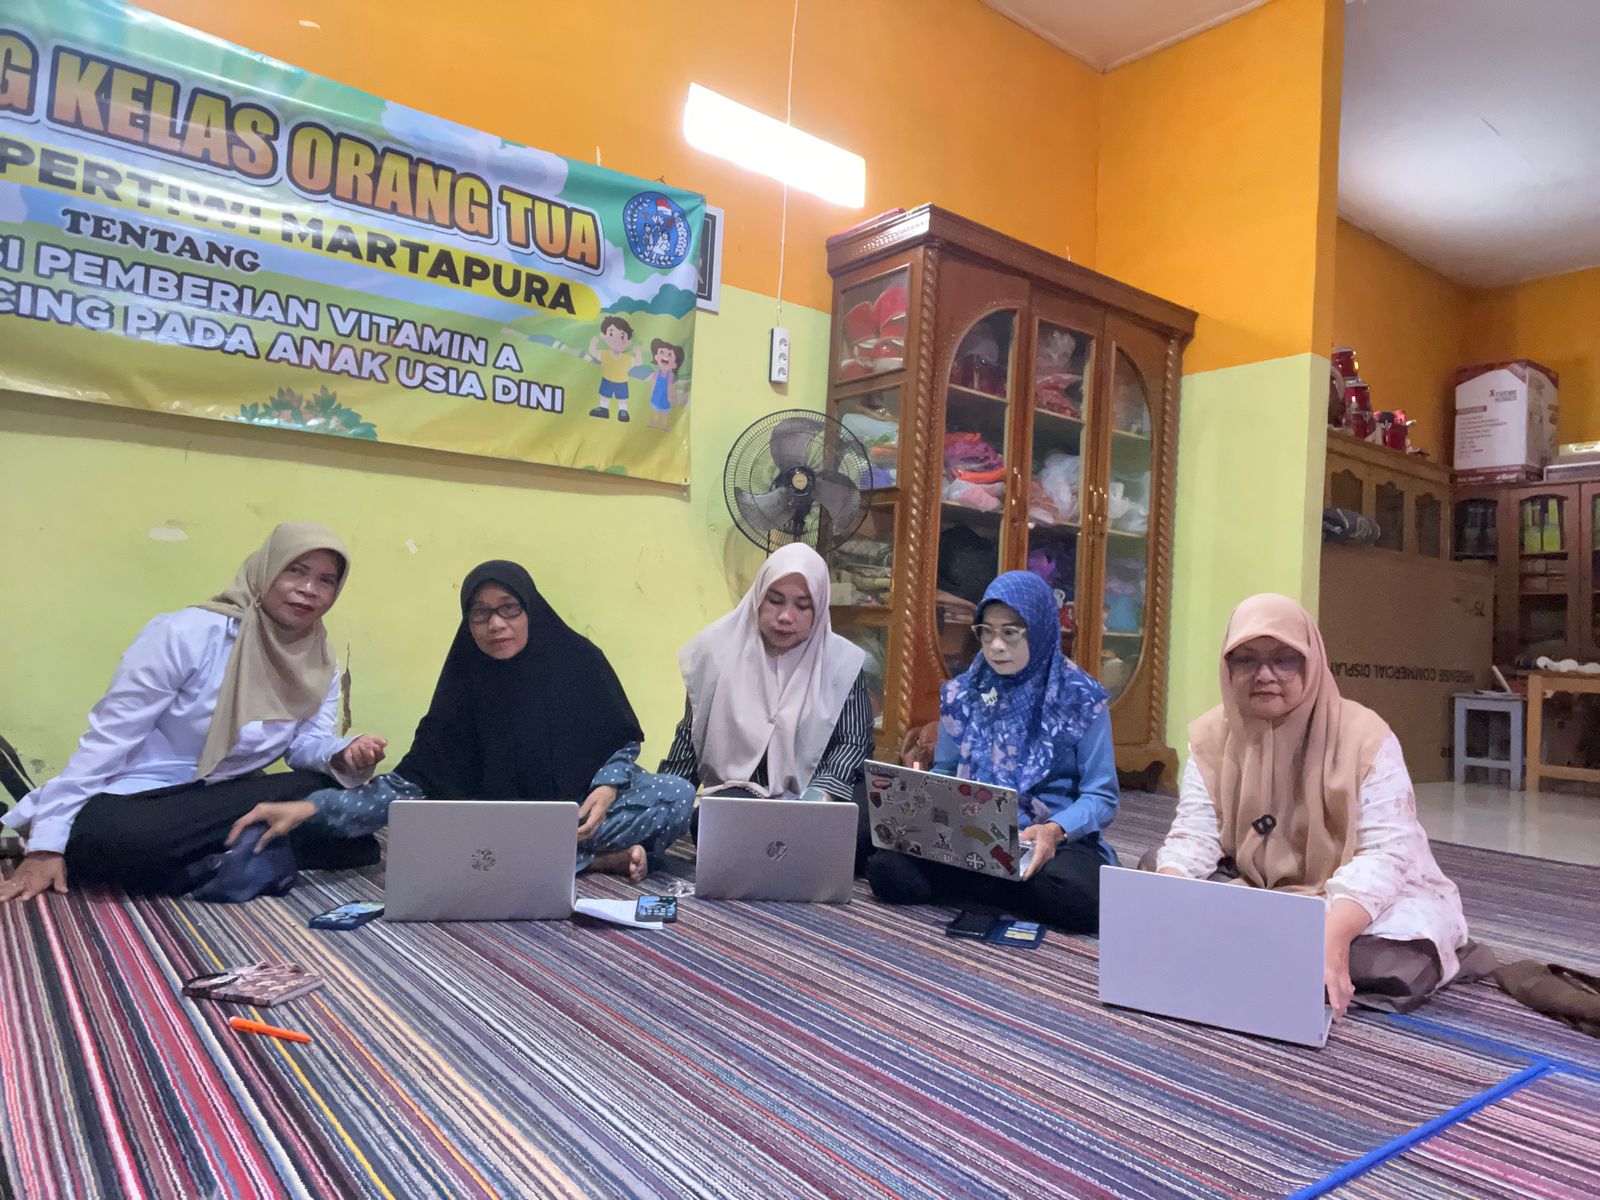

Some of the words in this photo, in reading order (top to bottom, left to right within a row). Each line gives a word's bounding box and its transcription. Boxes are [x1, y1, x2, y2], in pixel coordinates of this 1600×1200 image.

[47, 45, 280, 180] KELAS
[287, 121, 493, 239] ORANG
[500, 185, 602, 270] TUA
[61, 208, 261, 272] TENTANG
[281, 213, 576, 315] MARTAPURA
[34, 242, 320, 329] PEMBERIAN
[327, 303, 488, 366] VITAMIN
[494, 343, 522, 372] A
[124, 304, 260, 358] PADA
[266, 332, 389, 383] ANAK
[396, 358, 486, 400] USIA
[493, 375, 564, 413] DINI
[1375, 663, 1436, 682] COMMERCIAL
